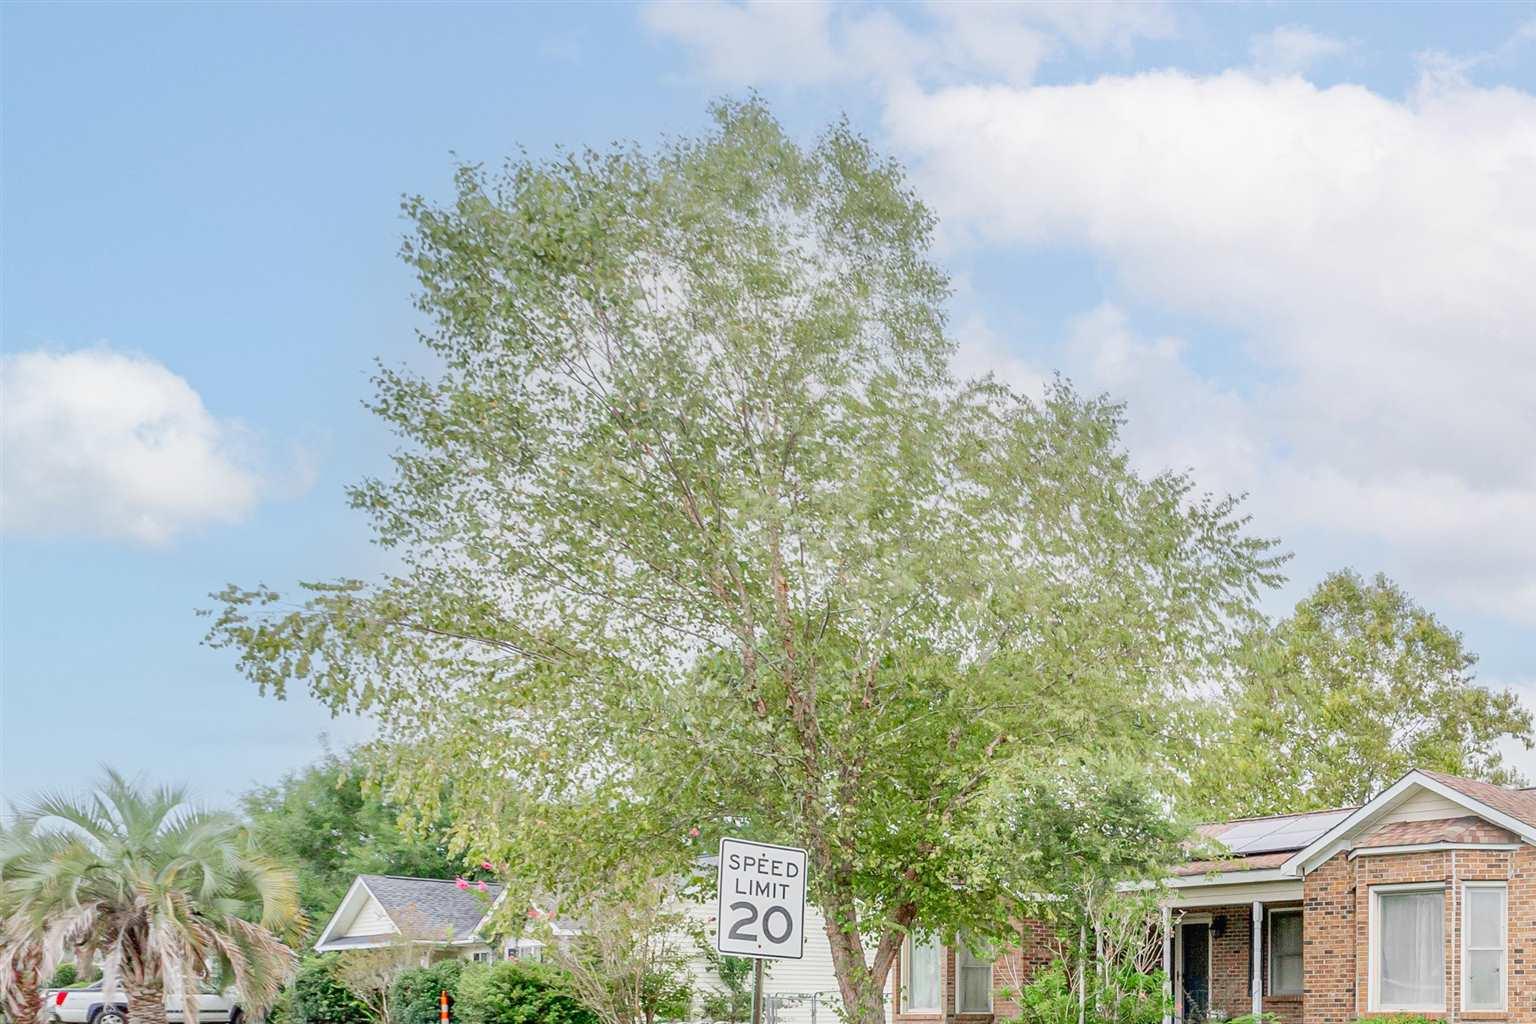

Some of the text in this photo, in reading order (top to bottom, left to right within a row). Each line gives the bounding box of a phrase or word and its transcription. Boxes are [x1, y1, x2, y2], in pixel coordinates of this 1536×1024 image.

[728, 854, 799, 878] SPEED
[735, 878, 790, 899] LIMIT
[728, 901, 793, 944] 20
